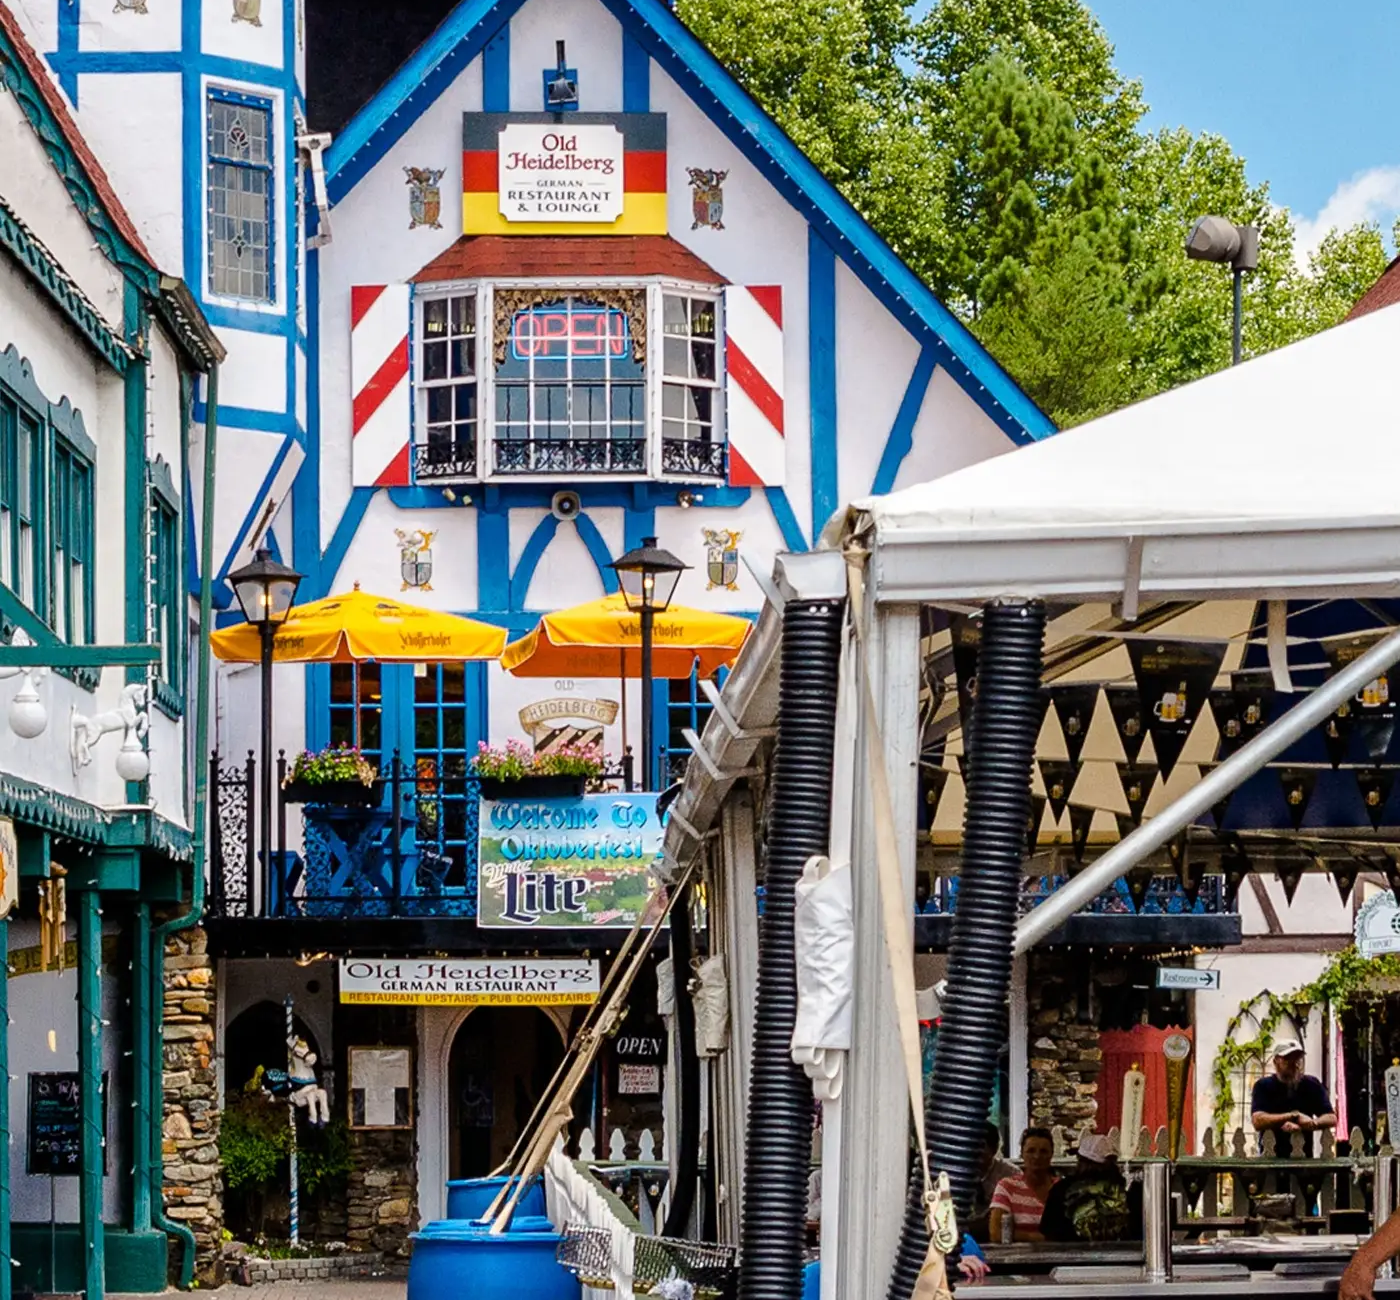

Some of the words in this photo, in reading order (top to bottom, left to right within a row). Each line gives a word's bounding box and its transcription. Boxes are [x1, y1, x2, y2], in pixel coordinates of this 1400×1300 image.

[542, 133, 577, 152] Old
[505, 153, 615, 175] Heidelberg
[508, 190, 611, 201] RESTAURANT
[518, 204, 529, 212] &
[538, 203, 602, 213] LOUNGE
[516, 314, 623, 355] OPEN
[555, 680, 574, 691] OLD
[530, 701, 607, 720] HEIDELBERG
[490, 803, 600, 830] Welcome
[611, 801, 648, 828] To
[500, 834, 643, 861] Oktoberfest
[500, 872, 591, 924] Lite
[347, 963, 402, 979] Old
[414, 964, 593, 983] Heidelberg
[381, 980, 446, 991] GERMAN
[455, 981, 558, 992] RESTAURANT
[349, 993, 420, 1002] RESTAURANT
[425, 994, 479, 1003] UPSTAIRS
[489, 994, 512, 1003] PUB
[518, 994, 592, 1003] DOWNSTAIRS
[617, 1037, 662, 1055] OPEN
